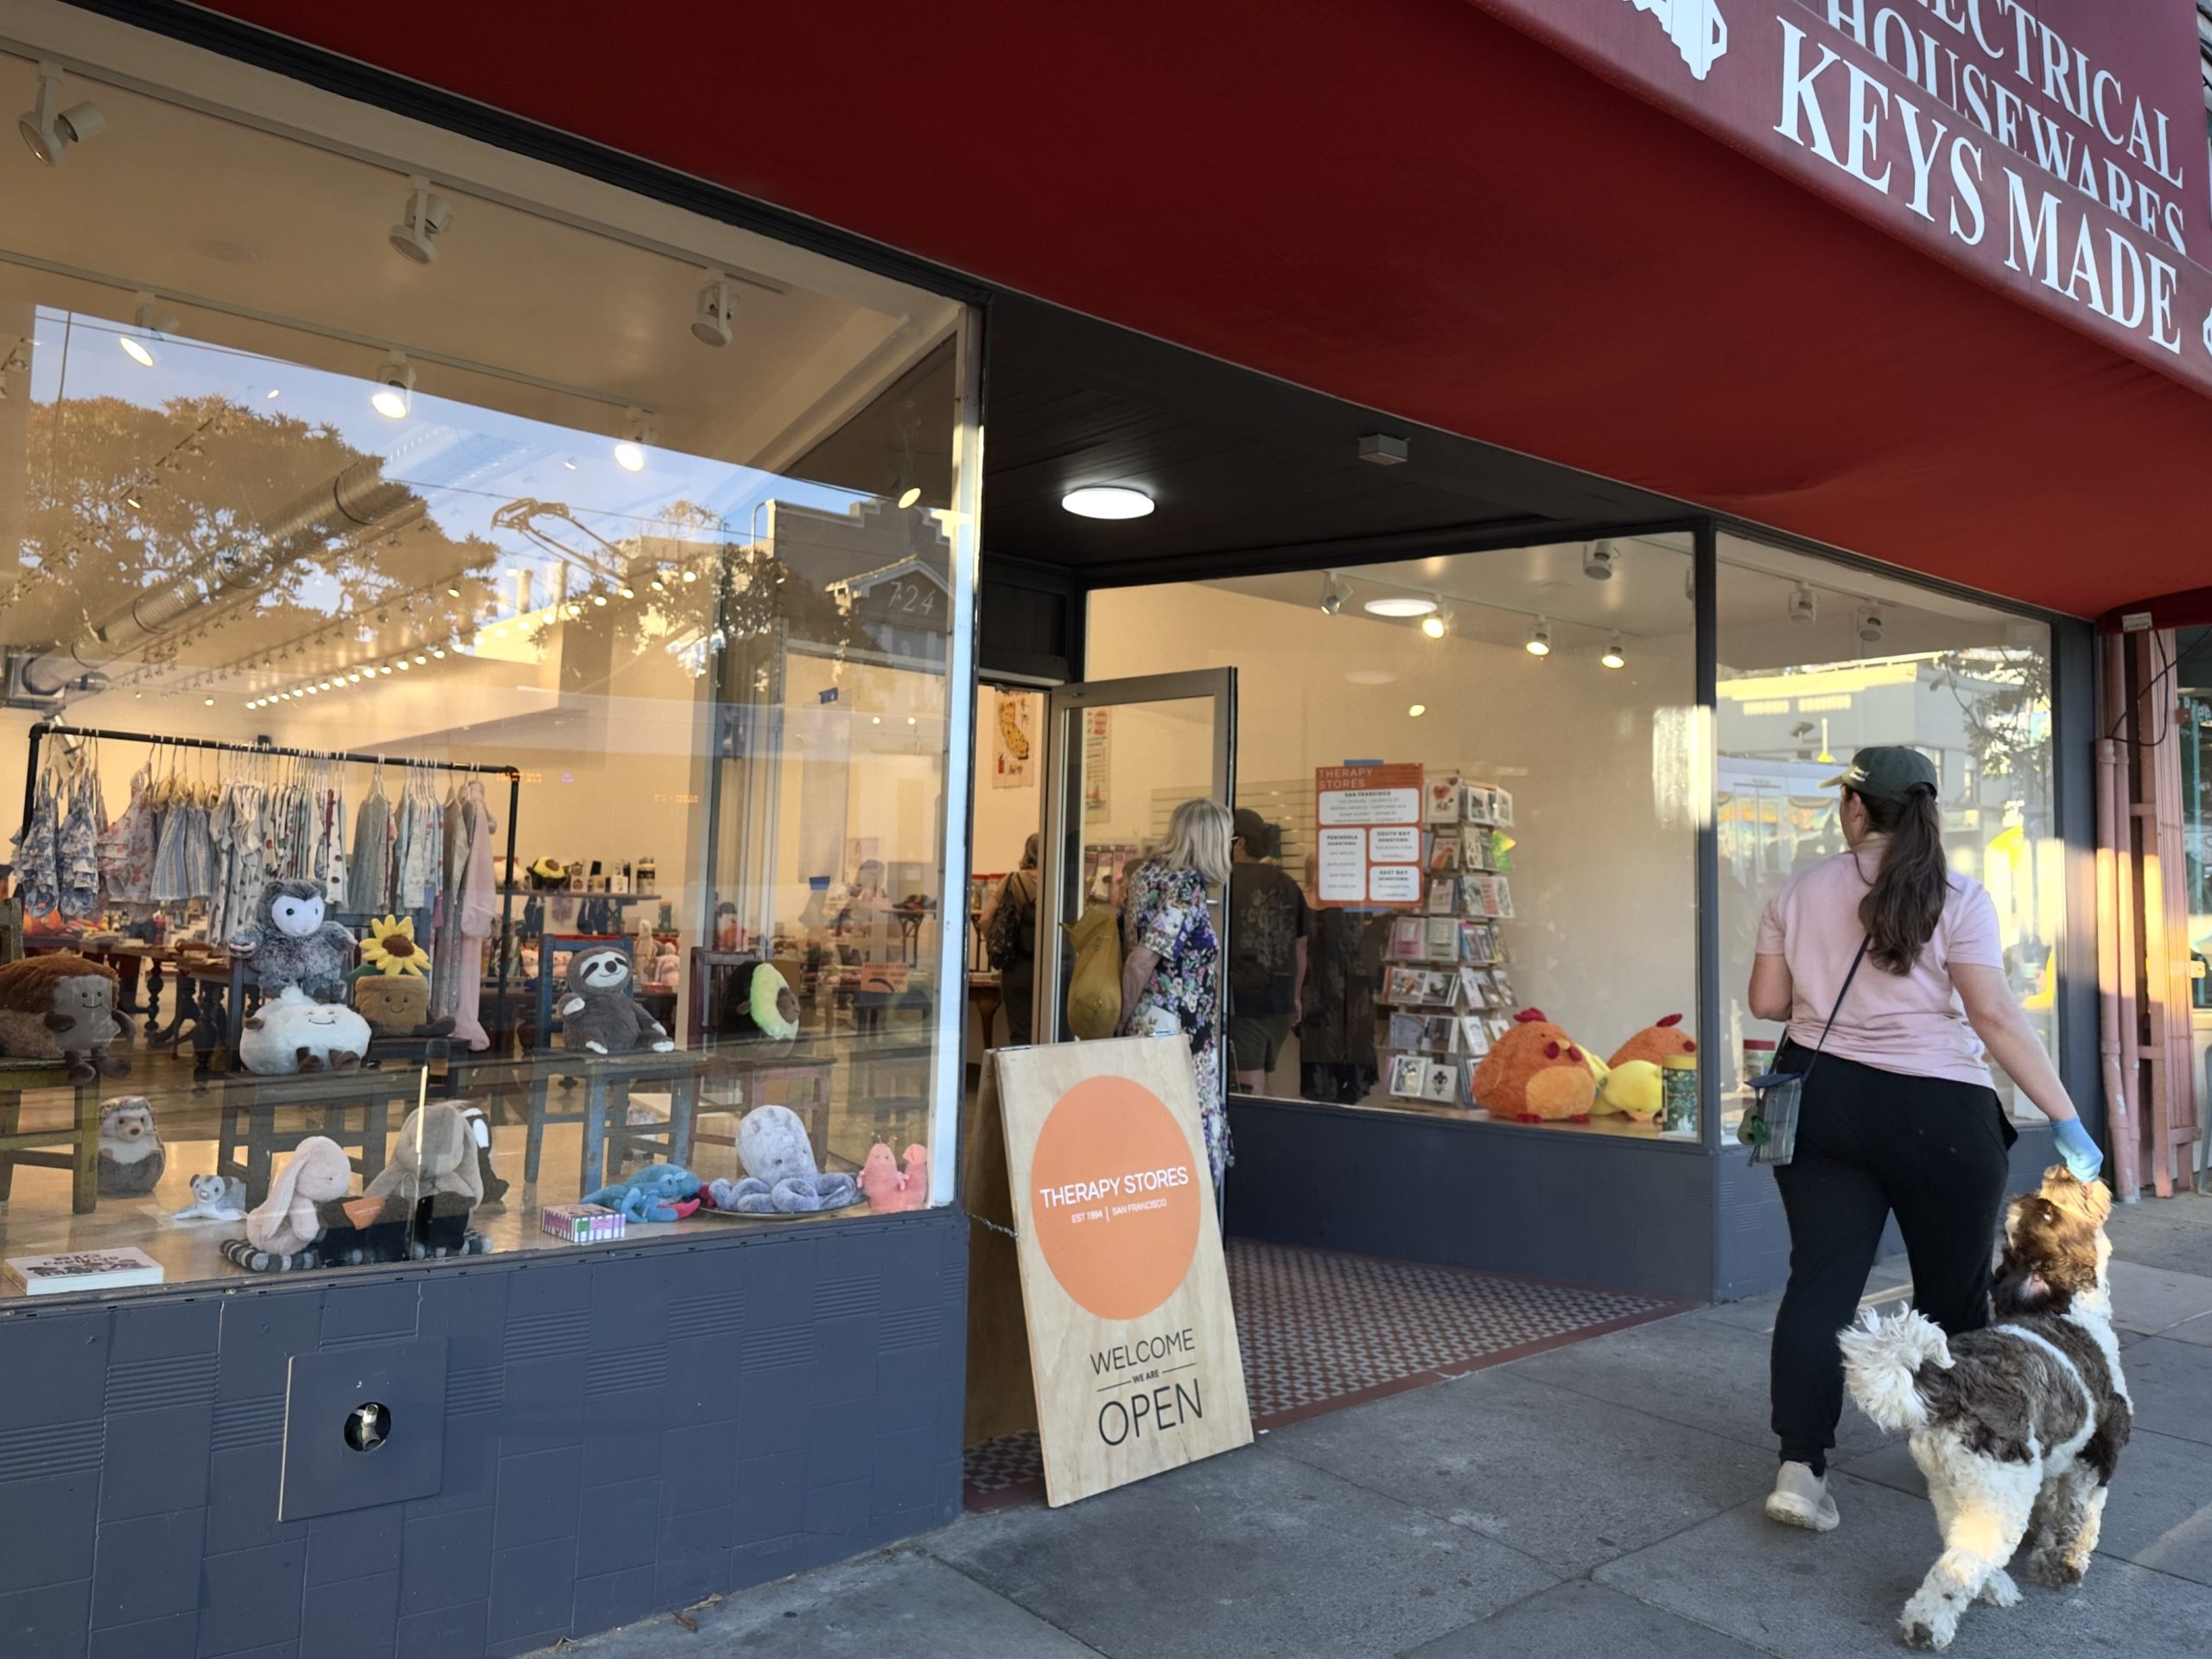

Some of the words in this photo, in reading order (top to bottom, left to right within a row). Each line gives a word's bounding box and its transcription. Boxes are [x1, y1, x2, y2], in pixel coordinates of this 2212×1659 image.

[1916, 0, 2183, 189] CTRICAL
[1773, 15, 1986, 246] KEYS
[2002, 166, 2181, 355] MADE
[888, 581, 936, 615] 724
[1319, 767, 1374, 778] THERAPY
[1319, 779, 1366, 789] STORES
[1039, 1177, 1121, 1208] THERAPY
[1124, 1166, 1190, 1194] STORES
[1071, 1212, 1086, 1224] EST
[1112, 1205, 1128, 1216] SAN
[1128, 1198, 1167, 1214] FRANCISCO
[1090, 1328, 1195, 1376] WELCOME
[1132, 1374, 1145, 1384] WE
[1146, 1370, 1160, 1382] ARE
[1098, 1378, 1203, 1446] OPEN
